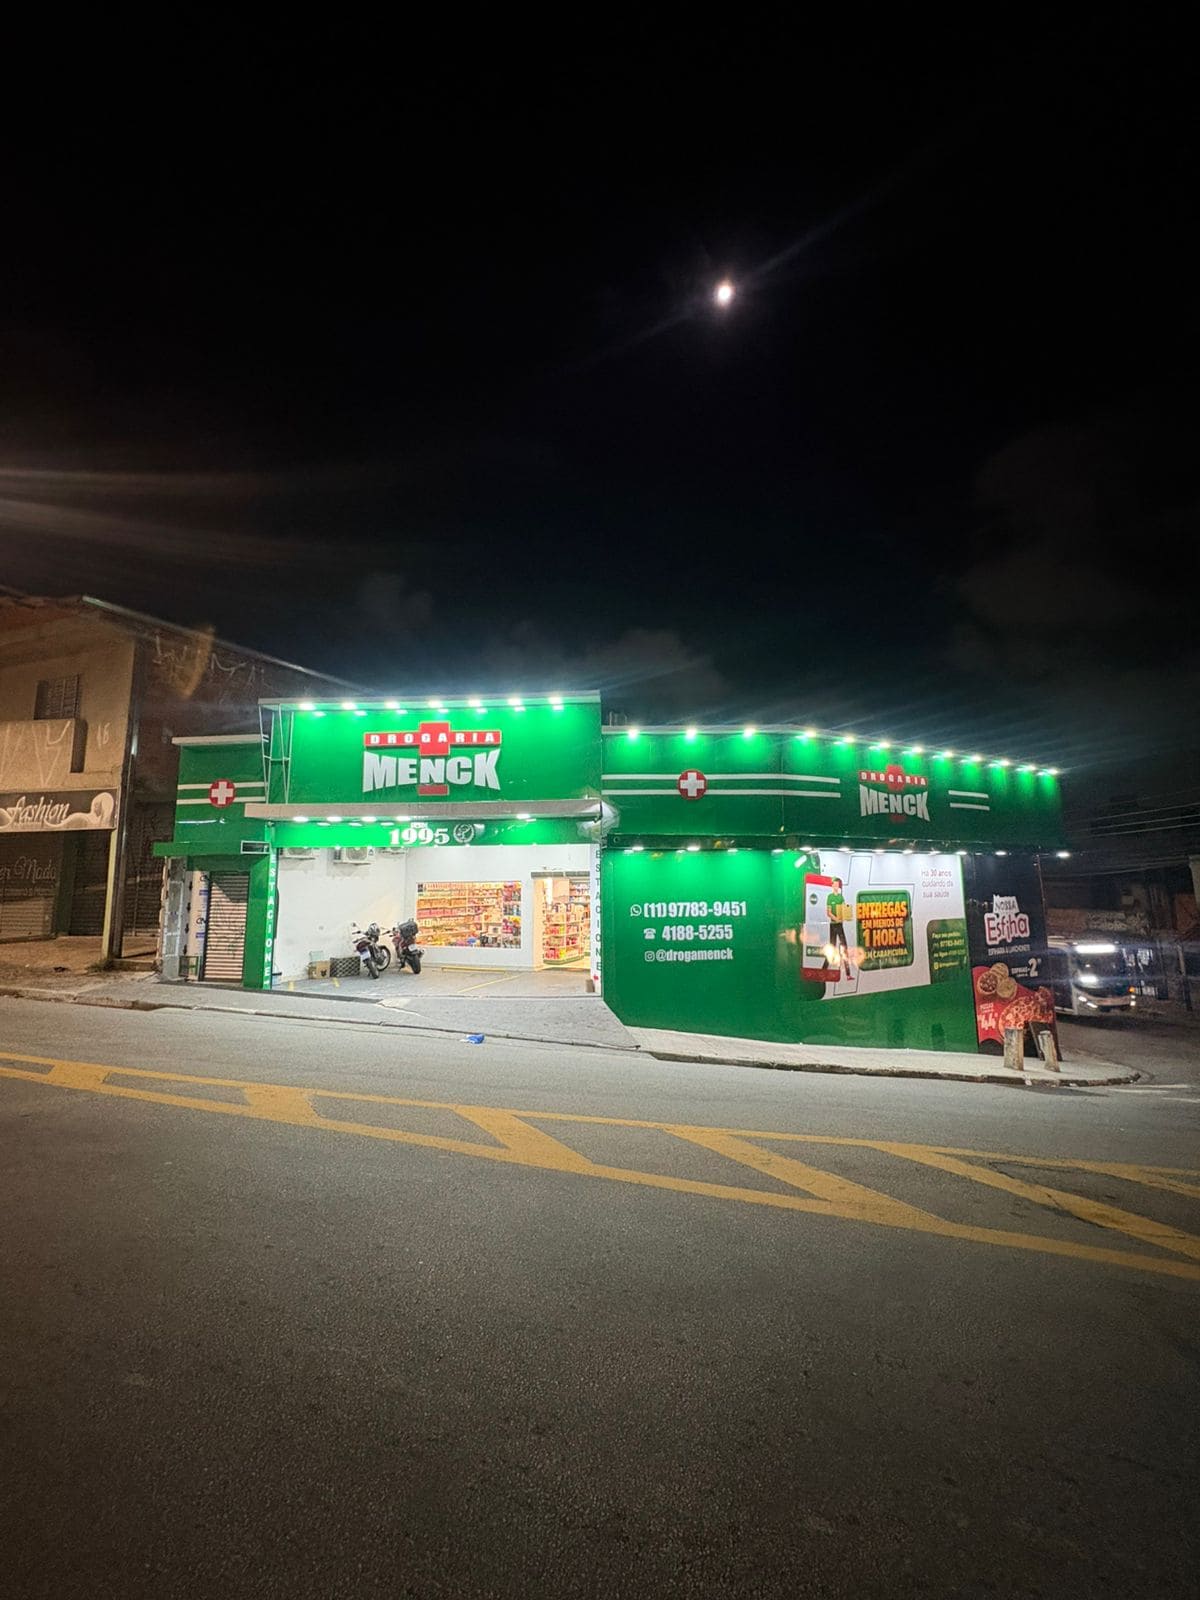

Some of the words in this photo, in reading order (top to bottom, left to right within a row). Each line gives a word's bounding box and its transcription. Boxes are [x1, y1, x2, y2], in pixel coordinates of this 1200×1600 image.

[370, 732, 495, 745] DROGARIA
[362, 748, 501, 793] MENCK
[861, 771, 927, 786] DROGARIA
[859, 783, 931, 822] MENCK
[389, 827, 451, 846] 1995
[643, 902, 667, 918] (11)
[668, 901, 747, 918] 97783-9451
[857, 901, 908, 919] ENTREGAS
[994, 900, 1017, 911] NOSSA
[862, 919, 873, 929] EM
[873, 918, 895, 928] MENOS
[896, 917, 904, 927] DE
[986, 914, 1028, 942] Esfiha
[662, 924, 734, 941] 4188-5255
[863, 929, 871, 947] 1
[873, 928, 905, 947] HORA
[656, 947, 734, 963] @drogamenck
